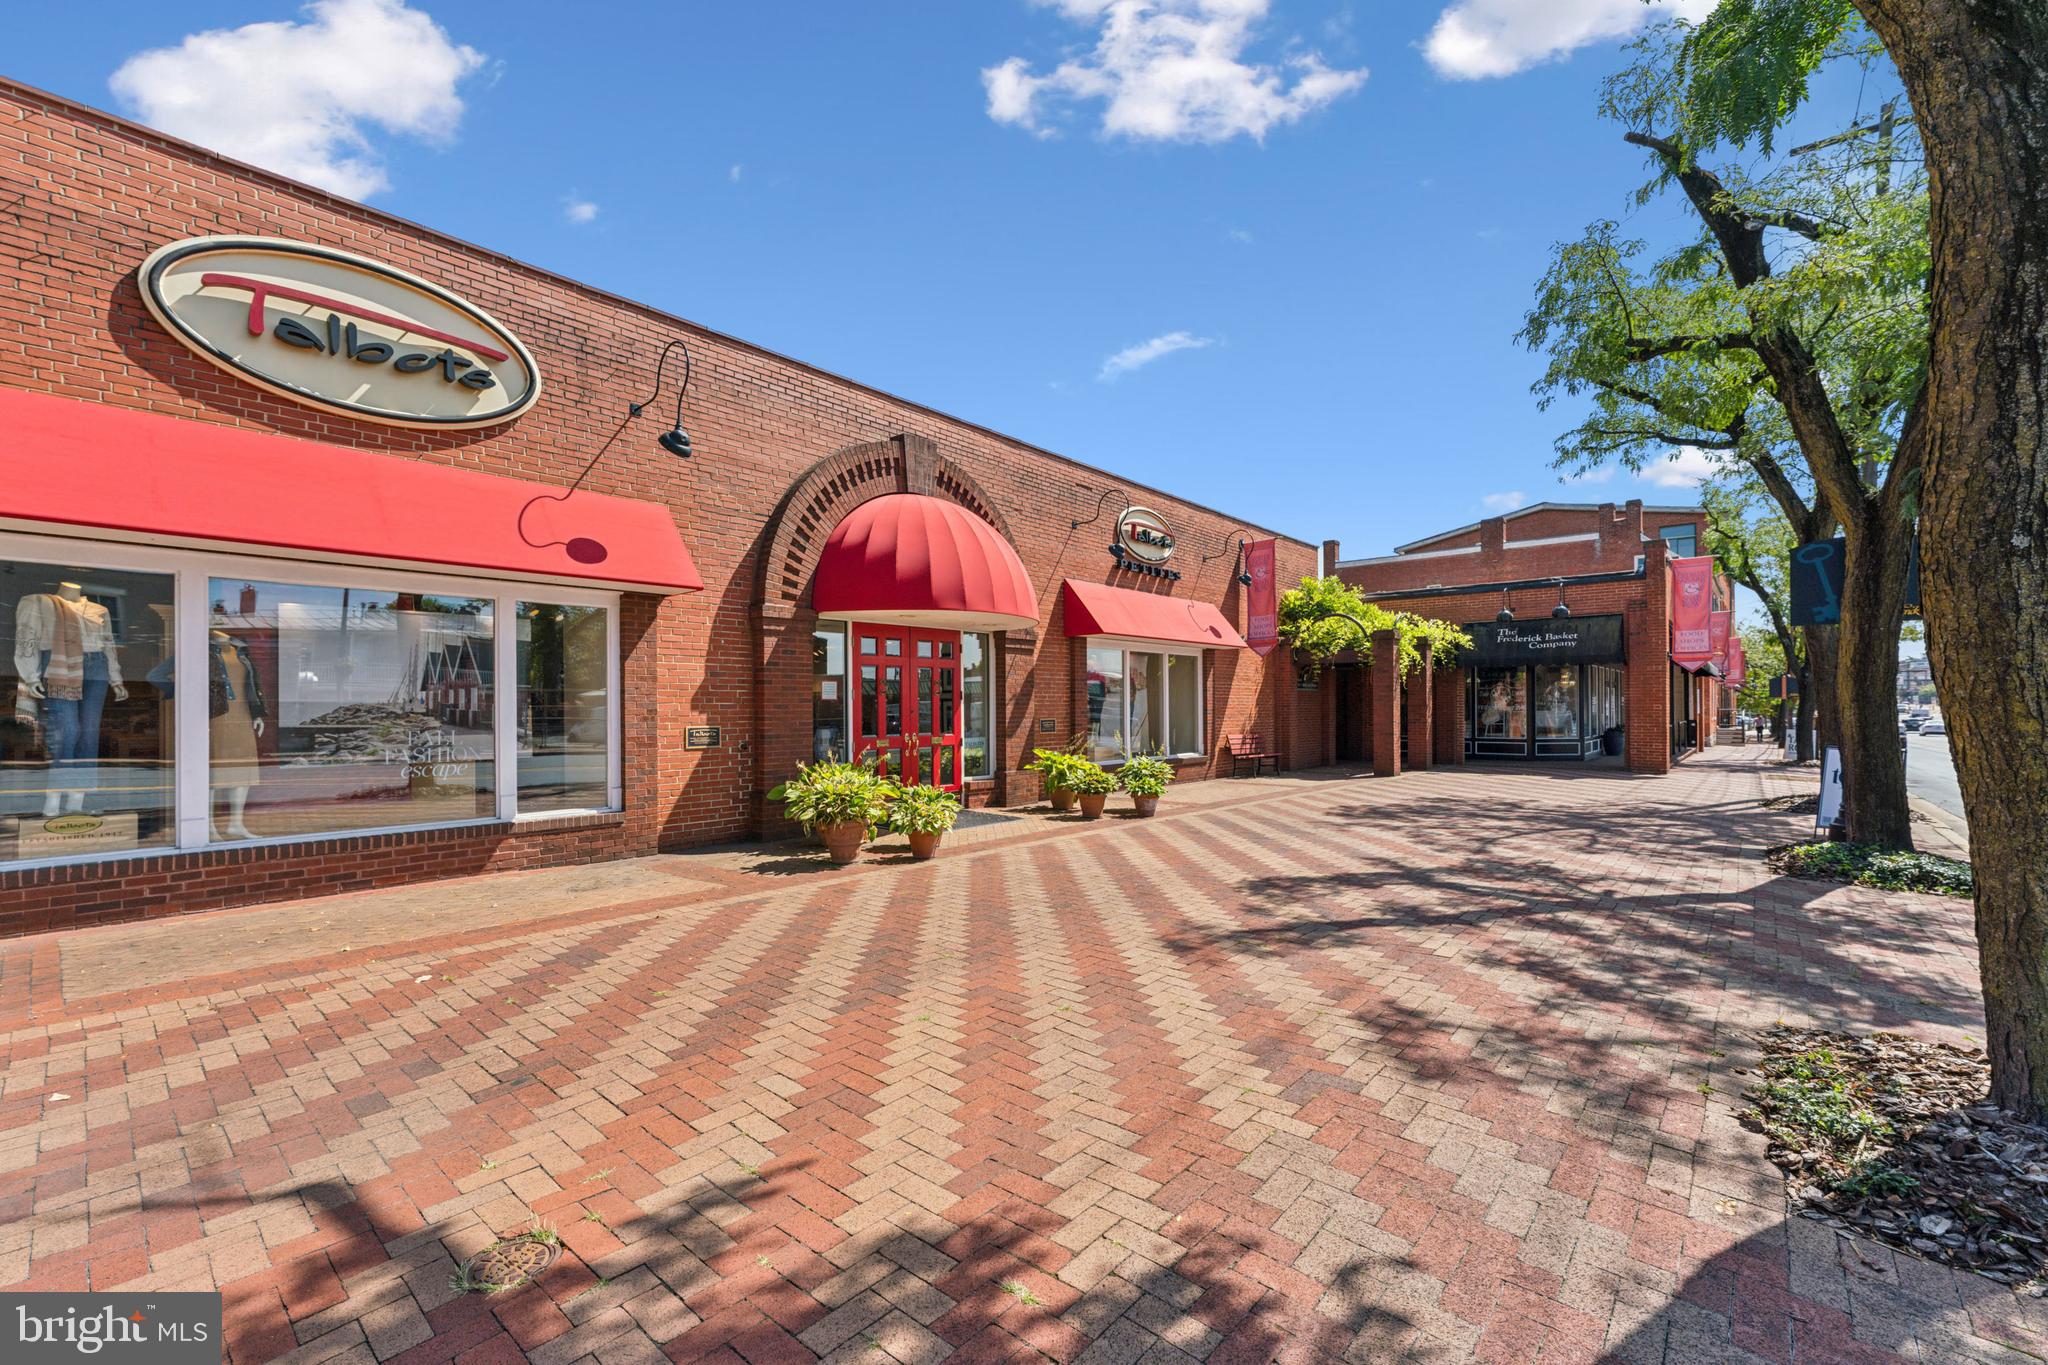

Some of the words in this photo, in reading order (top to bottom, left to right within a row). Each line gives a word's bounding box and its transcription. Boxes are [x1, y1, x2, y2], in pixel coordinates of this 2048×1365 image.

[201, 272, 510, 390] Talbots
[1123, 521, 1175, 548] Talbots
[1116, 559, 1182, 580] PETITES
[1496, 634, 1542, 643] Frederick
[1545, 632, 1579, 641] Basket
[1497, 628, 1518, 636] The
[1528, 640, 1578, 649] Company
[408, 730, 456, 747] FALL
[385, 746, 482, 765] FASHION
[400, 762, 469, 780] escape
